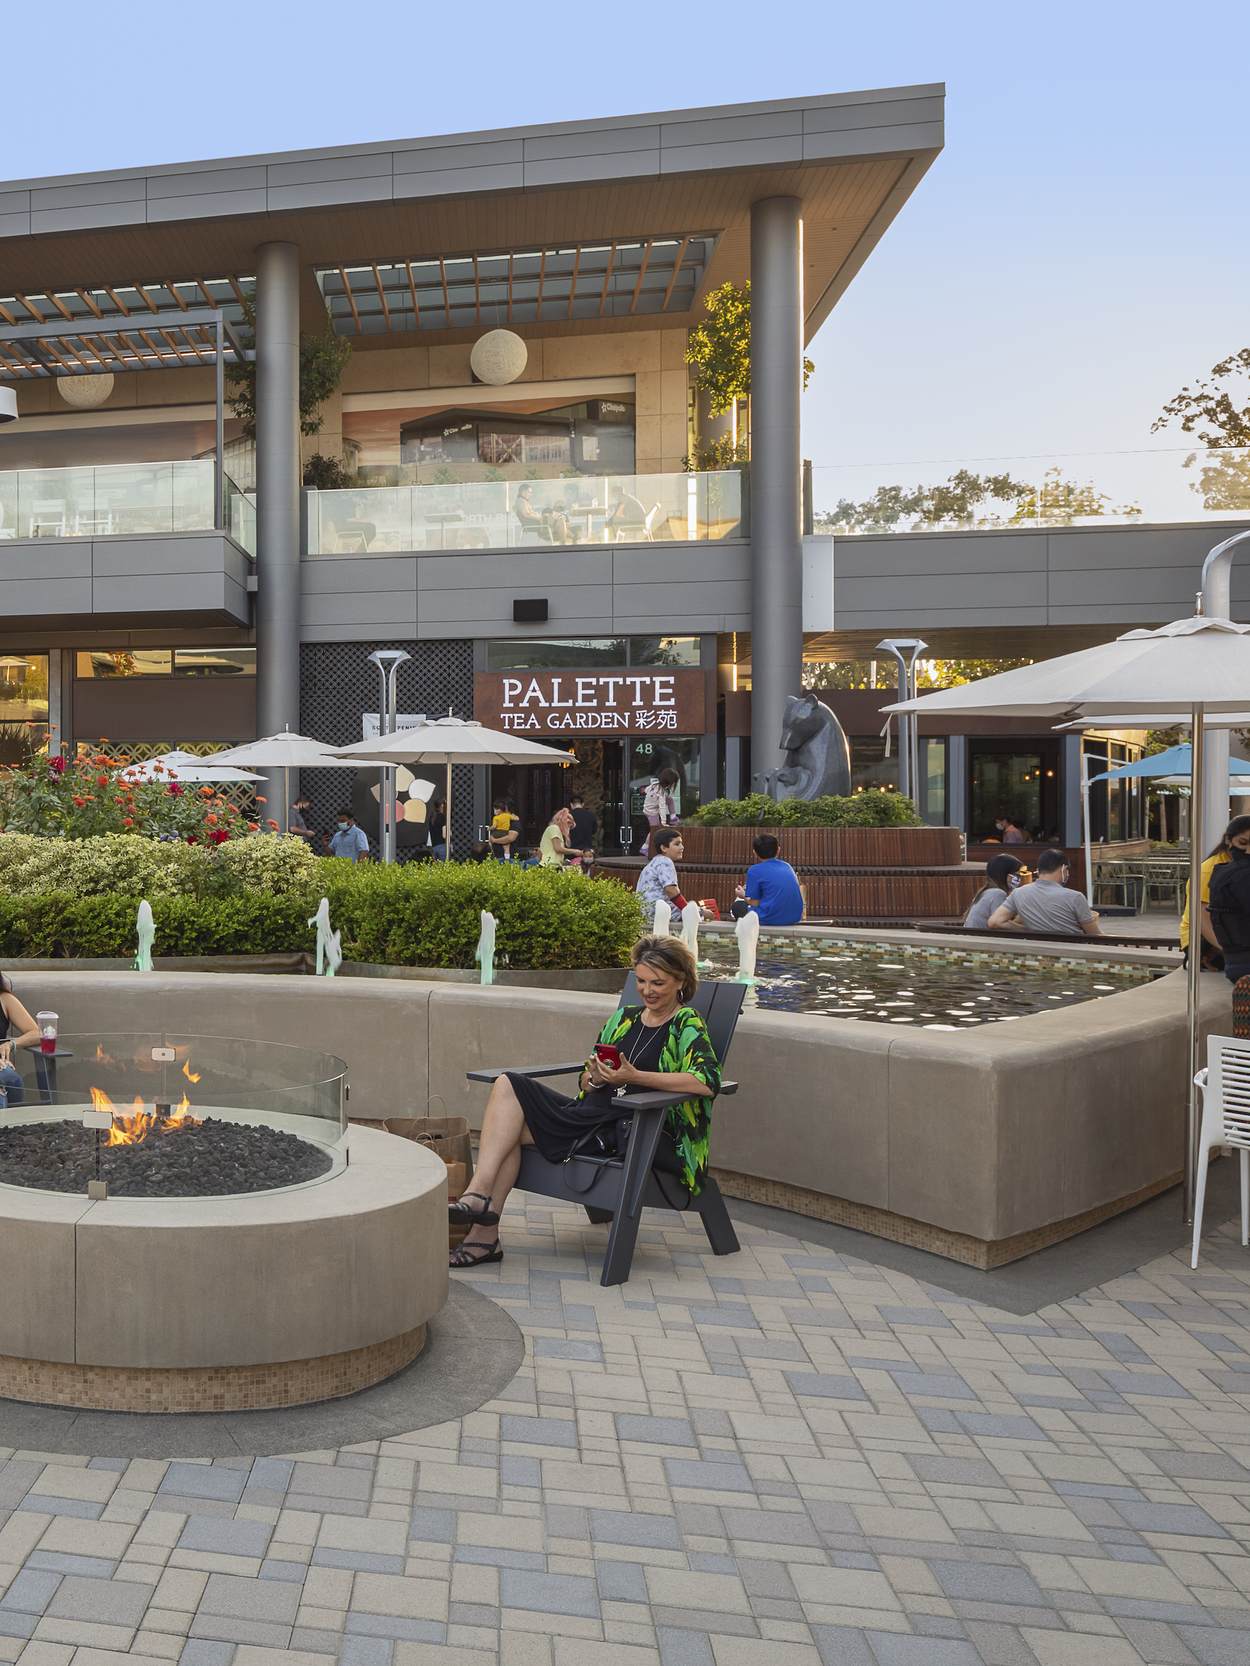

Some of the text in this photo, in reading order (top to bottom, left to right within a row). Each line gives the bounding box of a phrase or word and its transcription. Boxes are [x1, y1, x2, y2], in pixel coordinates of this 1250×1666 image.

[502, 676, 676, 708] PALETTE
[500, 709, 678, 730] TEA GARDEN 彩苑
[635, 743, 653, 754] 48
